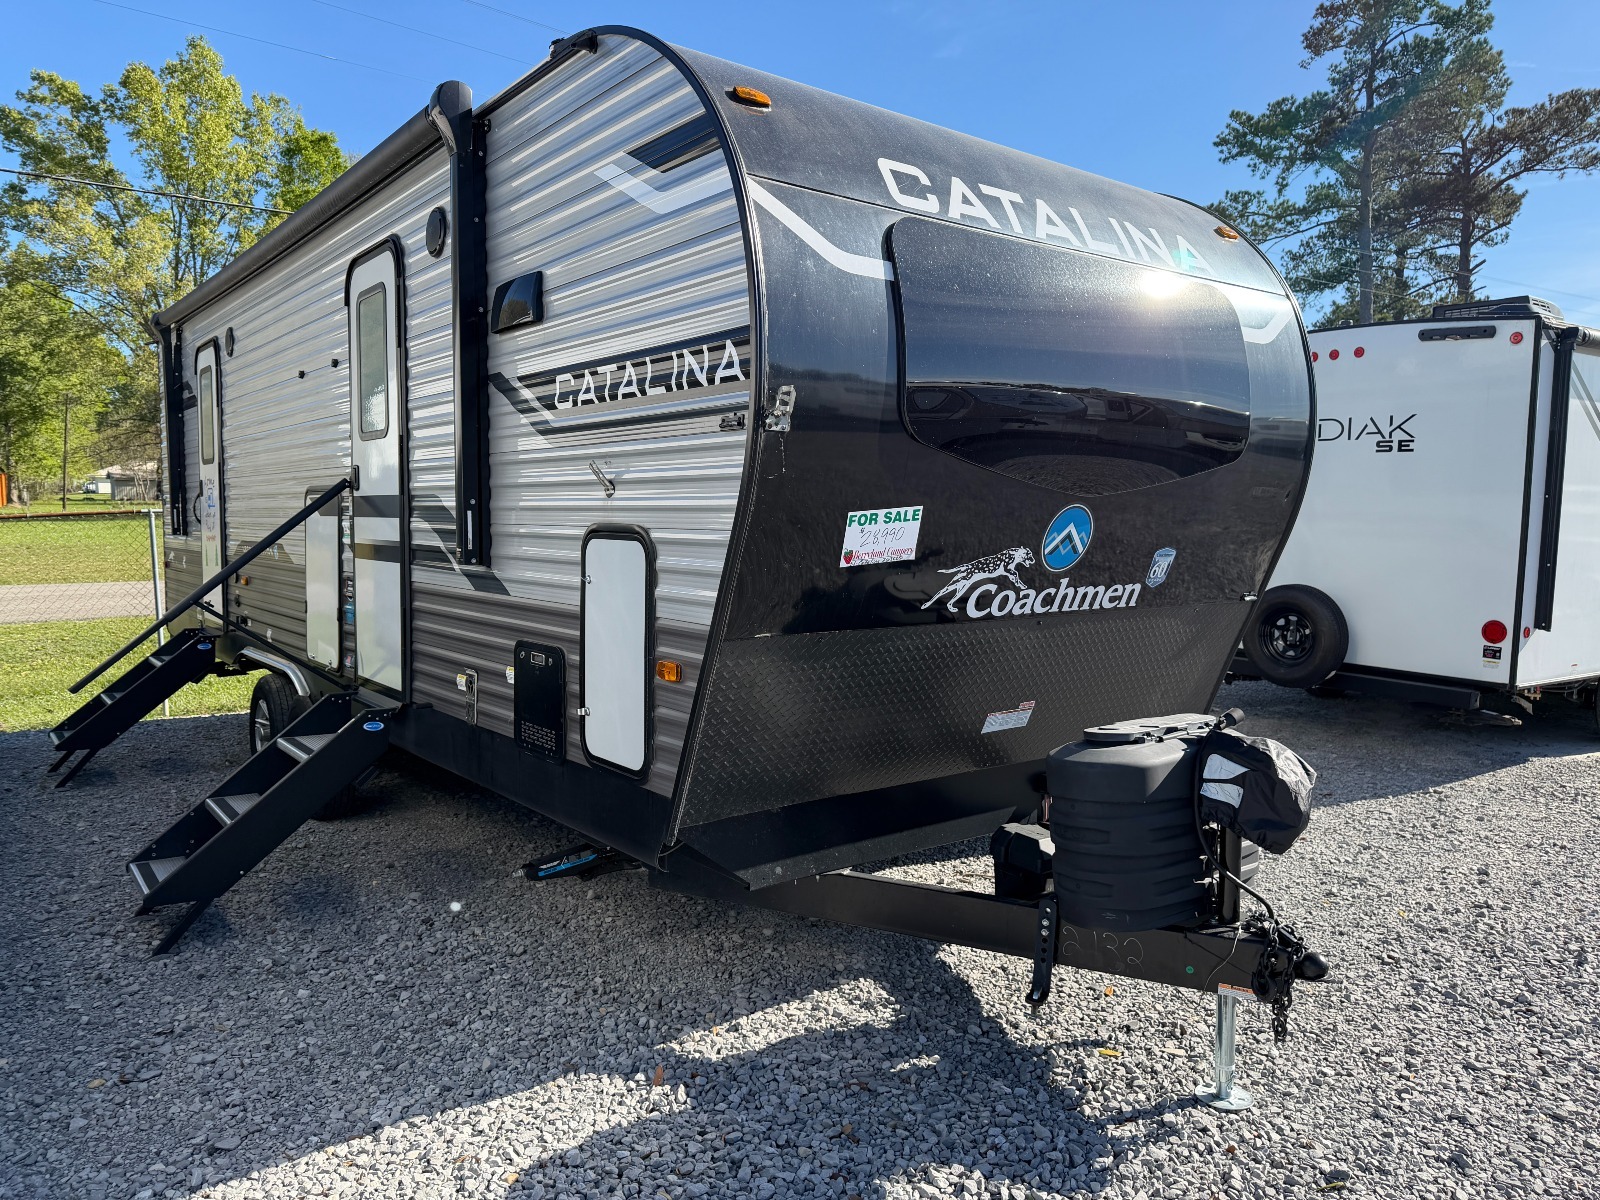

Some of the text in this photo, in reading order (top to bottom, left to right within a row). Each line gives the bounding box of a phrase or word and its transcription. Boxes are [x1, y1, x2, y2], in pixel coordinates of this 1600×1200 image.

[877, 157, 1215, 274] CATALINA
[555, 339, 746, 410] CATALINA
[1375, 439, 1415, 453] SE
[847, 508, 922, 528] FOR SALE
[1150, 561, 1168, 578] 60
[966, 577, 1142, 619] Coachmen
